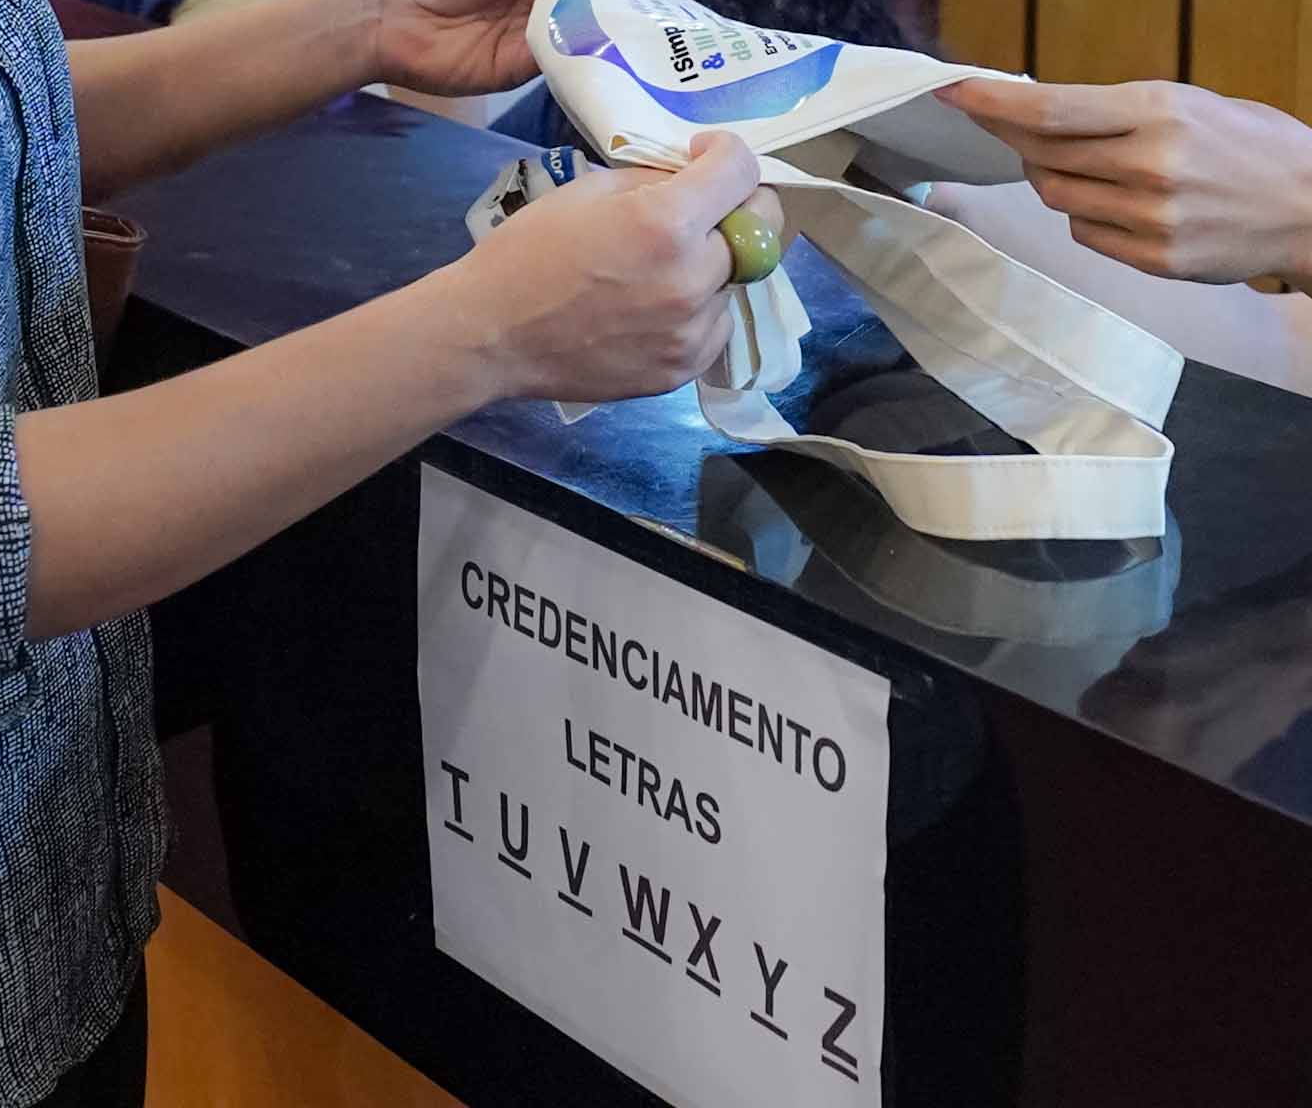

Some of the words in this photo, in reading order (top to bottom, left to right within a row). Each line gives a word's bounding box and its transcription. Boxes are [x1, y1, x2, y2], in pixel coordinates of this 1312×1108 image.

[664, 26, 695, 73] Simp
[461, 560, 846, 792] CREDENCIAMENTO
[564, 718, 722, 845] LETRAS
[441, 760, 470, 824] T
[499, 792, 529, 861] U
[559, 826, 590, 896] V
[619, 863, 671, 946] W
[687, 901, 722, 983] X
[753, 941, 788, 1018] Y
[821, 986, 858, 1069] Z
